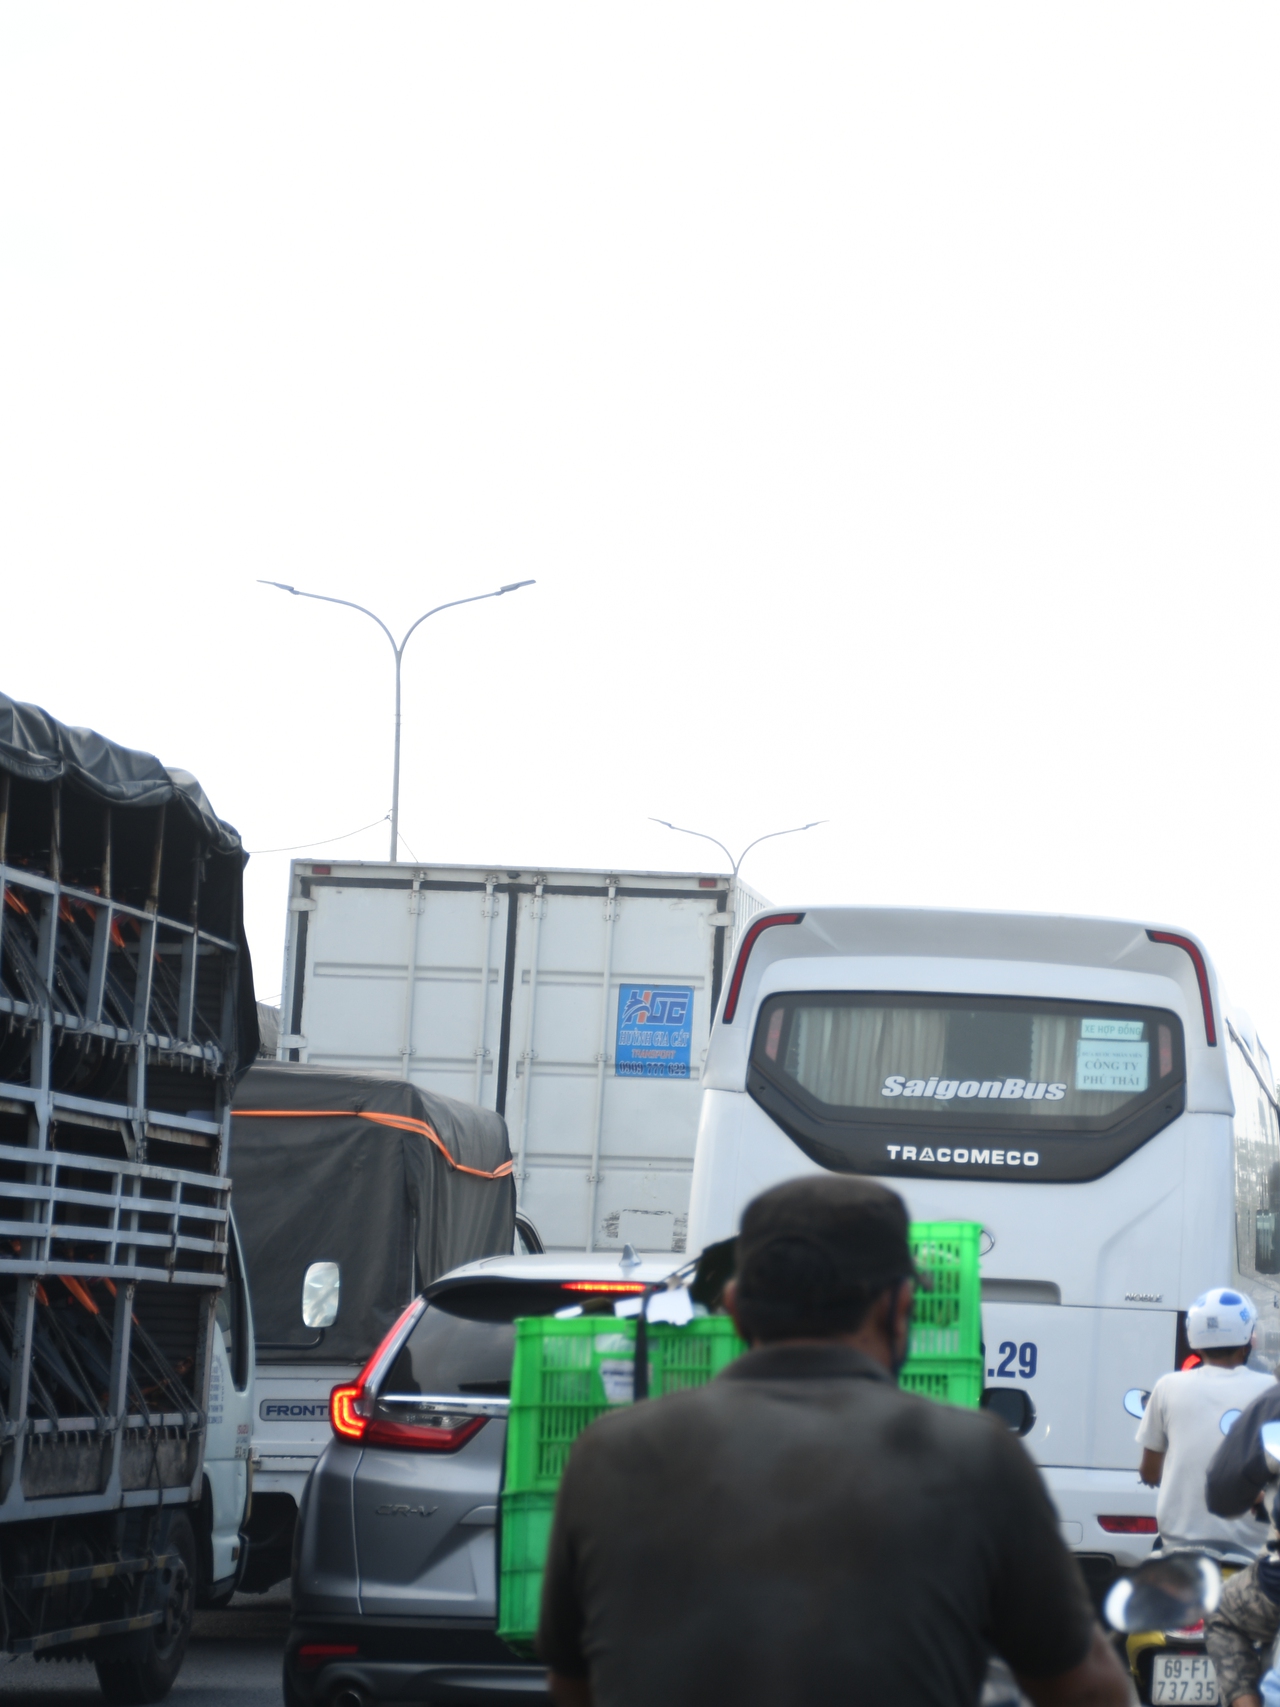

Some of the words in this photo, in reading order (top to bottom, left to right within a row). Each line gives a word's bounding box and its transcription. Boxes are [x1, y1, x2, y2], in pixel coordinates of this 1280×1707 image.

[653, 1031, 669, 1046] GIA
[632, 1049, 676, 1059] TRANSPORT
[620, 1061, 643, 1074] 0909
[647, 1062, 665, 1075] 777
[668, 1063, 686, 1076] 622
[1084, 1059, 1120, 1071] CÔNG
[1122, 1061, 1139, 1071] TY
[881, 1076, 1067, 1100] SaigonBus
[886, 1145, 1039, 1166] TRACOMECO
[1124, 1292, 1164, 1303] NOBLE
[1164, 1660, 1209, 1679] 69-F1
[1157, 1681, 1215, 1701] 737.35
